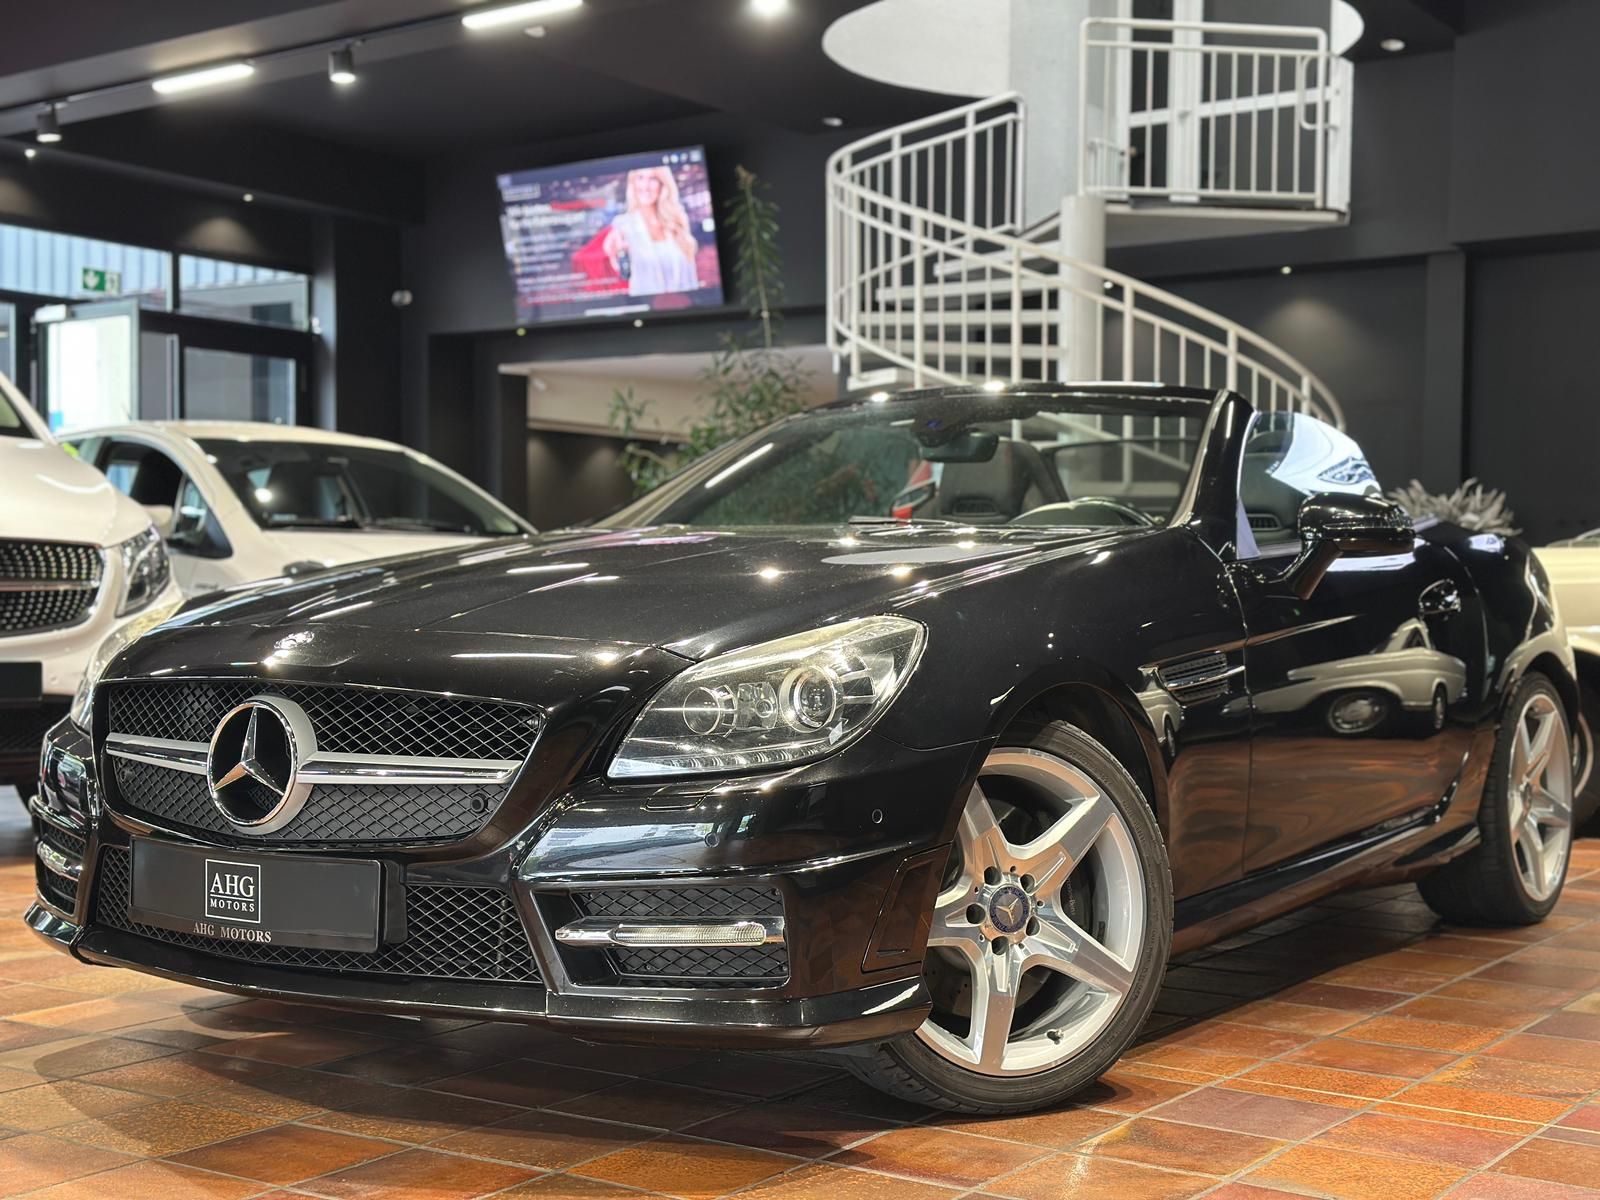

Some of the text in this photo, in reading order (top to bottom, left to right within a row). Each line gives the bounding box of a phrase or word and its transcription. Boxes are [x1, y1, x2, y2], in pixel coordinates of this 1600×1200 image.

[210, 872, 255, 897] AHG
[210, 898, 255, 912] MOTORS
[193, 922, 272, 943] AHG MOTORS
